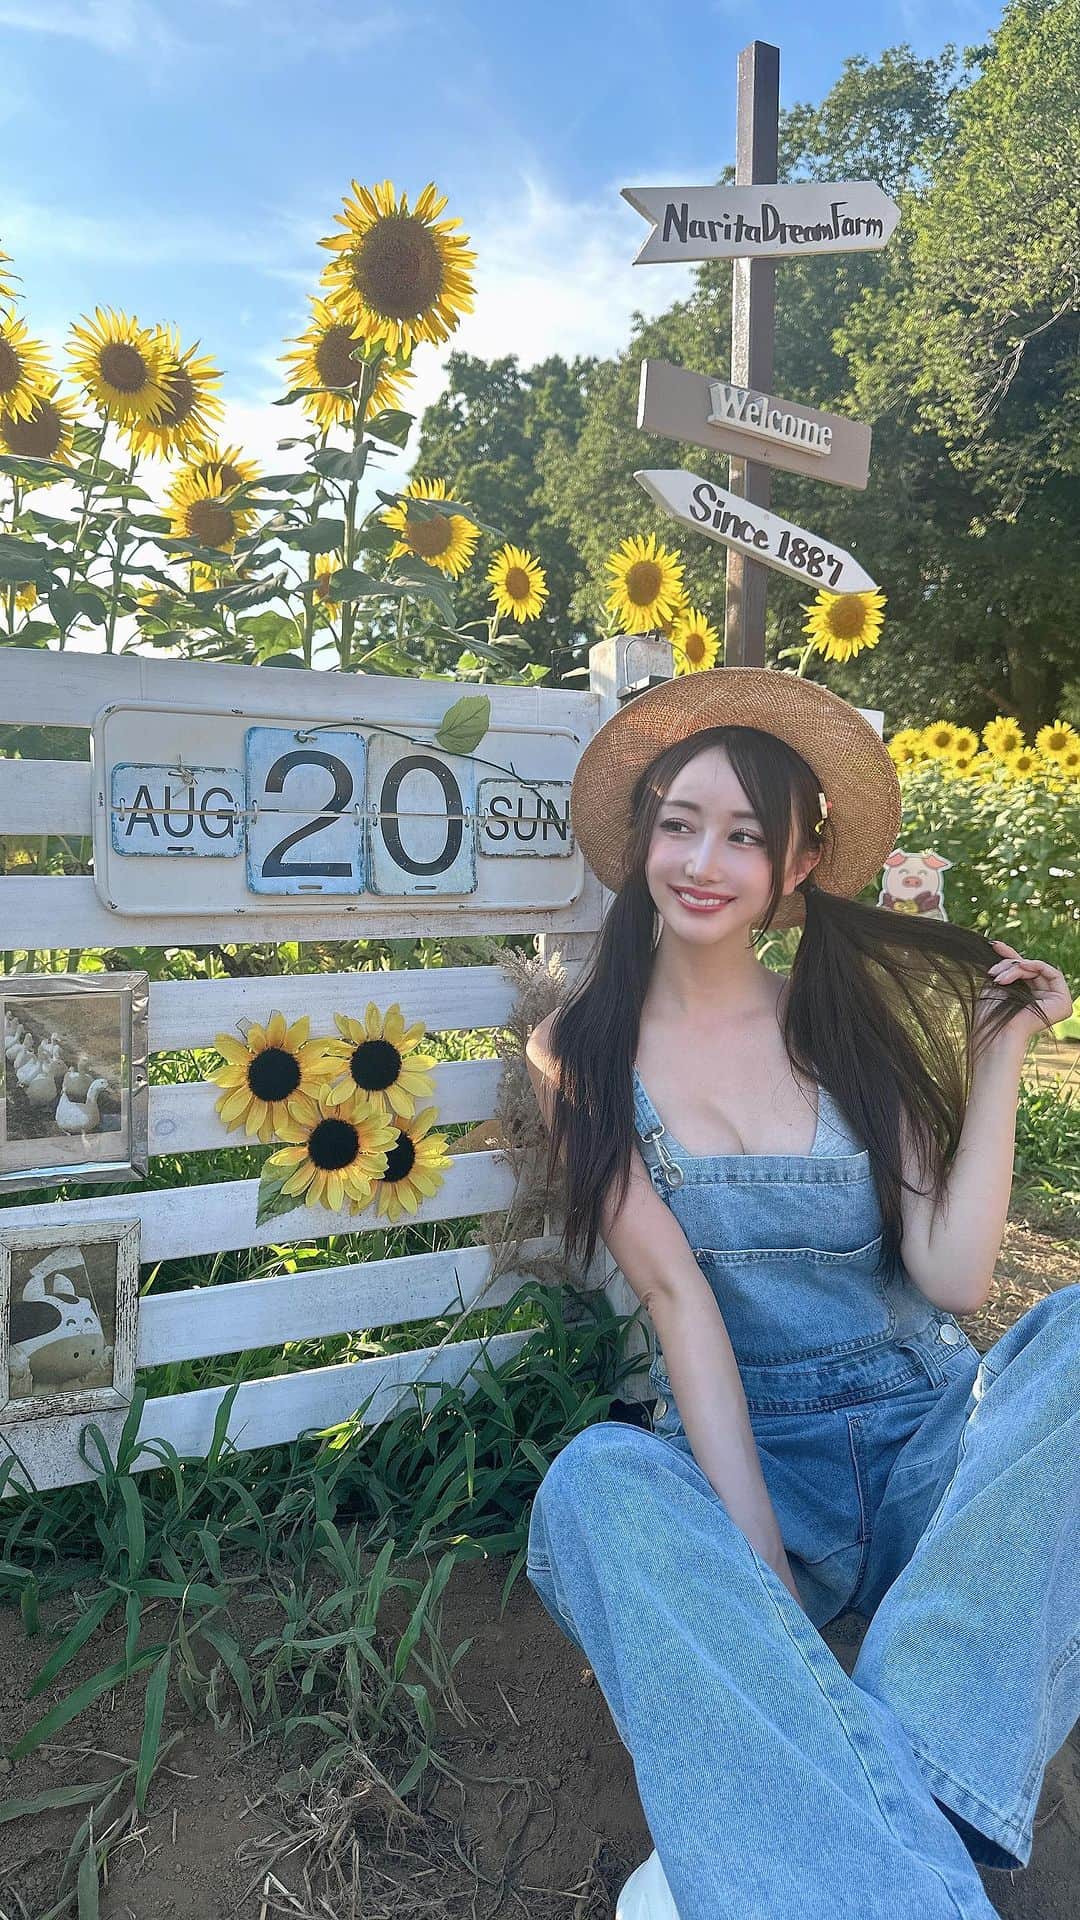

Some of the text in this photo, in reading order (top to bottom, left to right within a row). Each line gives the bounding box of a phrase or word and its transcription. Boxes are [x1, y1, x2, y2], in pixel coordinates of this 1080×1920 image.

[708, 382, 832, 453] Welcome
[690, 484, 844, 587] Since 1887
[125, 749, 570, 878] AUG 20 SUN
